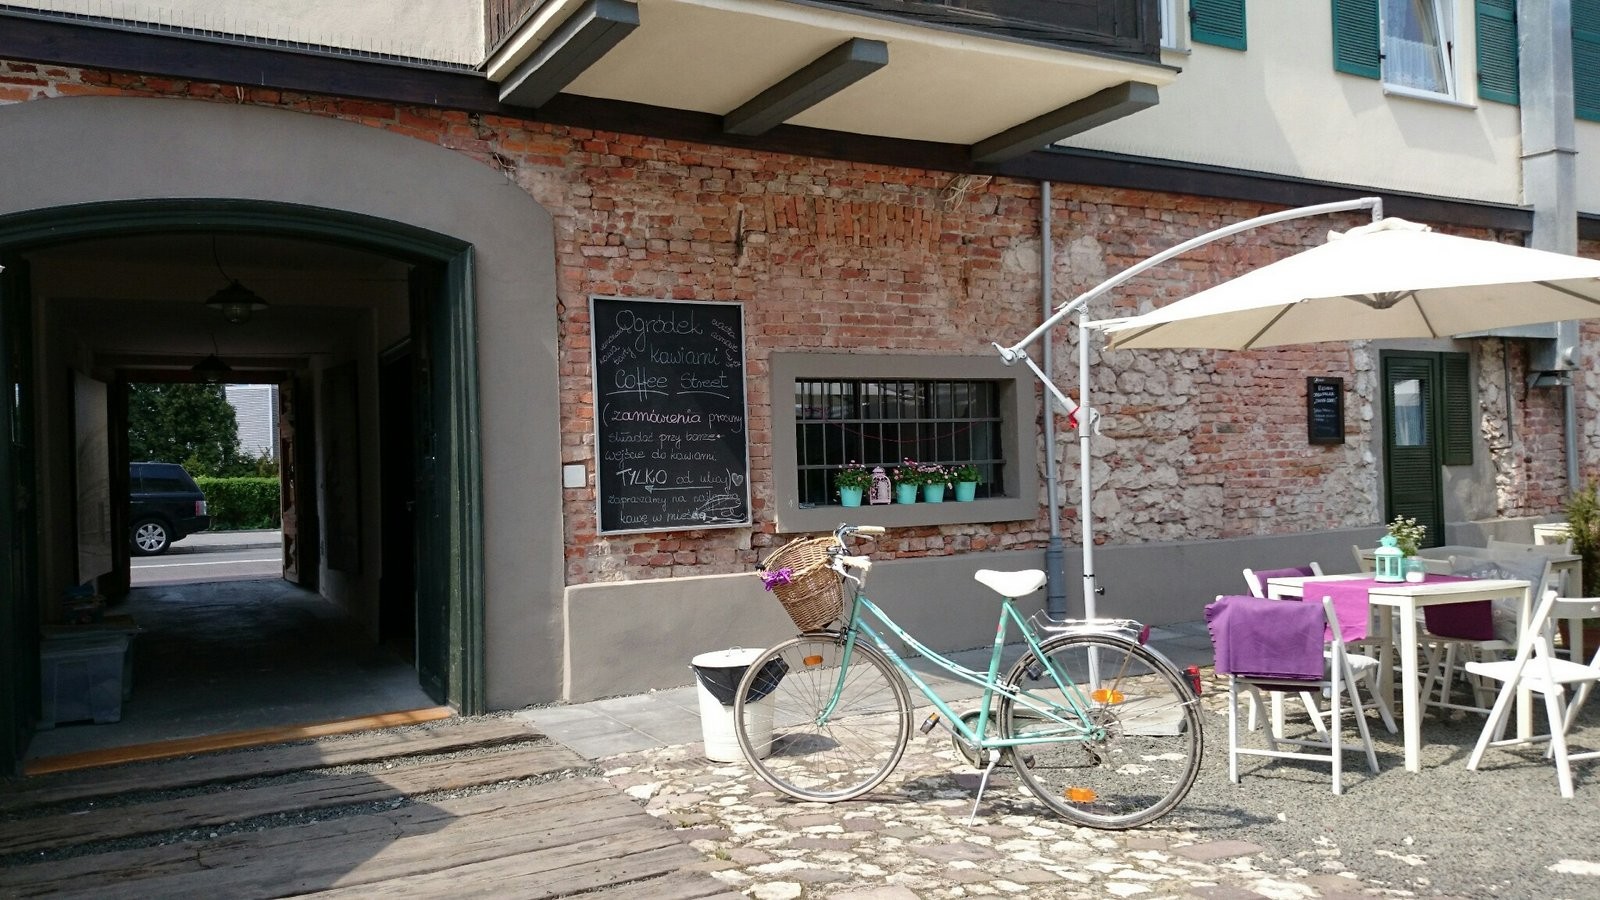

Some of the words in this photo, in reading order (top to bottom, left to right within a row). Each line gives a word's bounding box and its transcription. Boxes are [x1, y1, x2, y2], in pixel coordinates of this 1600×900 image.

[614, 366, 669, 402] Coffee
[680, 370, 729, 389] Street
[658, 433, 682, 449] przy
[651, 448, 667, 460] do
[615, 467, 668, 487] TYLKO
[676, 470, 694, 485] od
[672, 495, 687, 504] na
[652, 514, 663, 523] w
